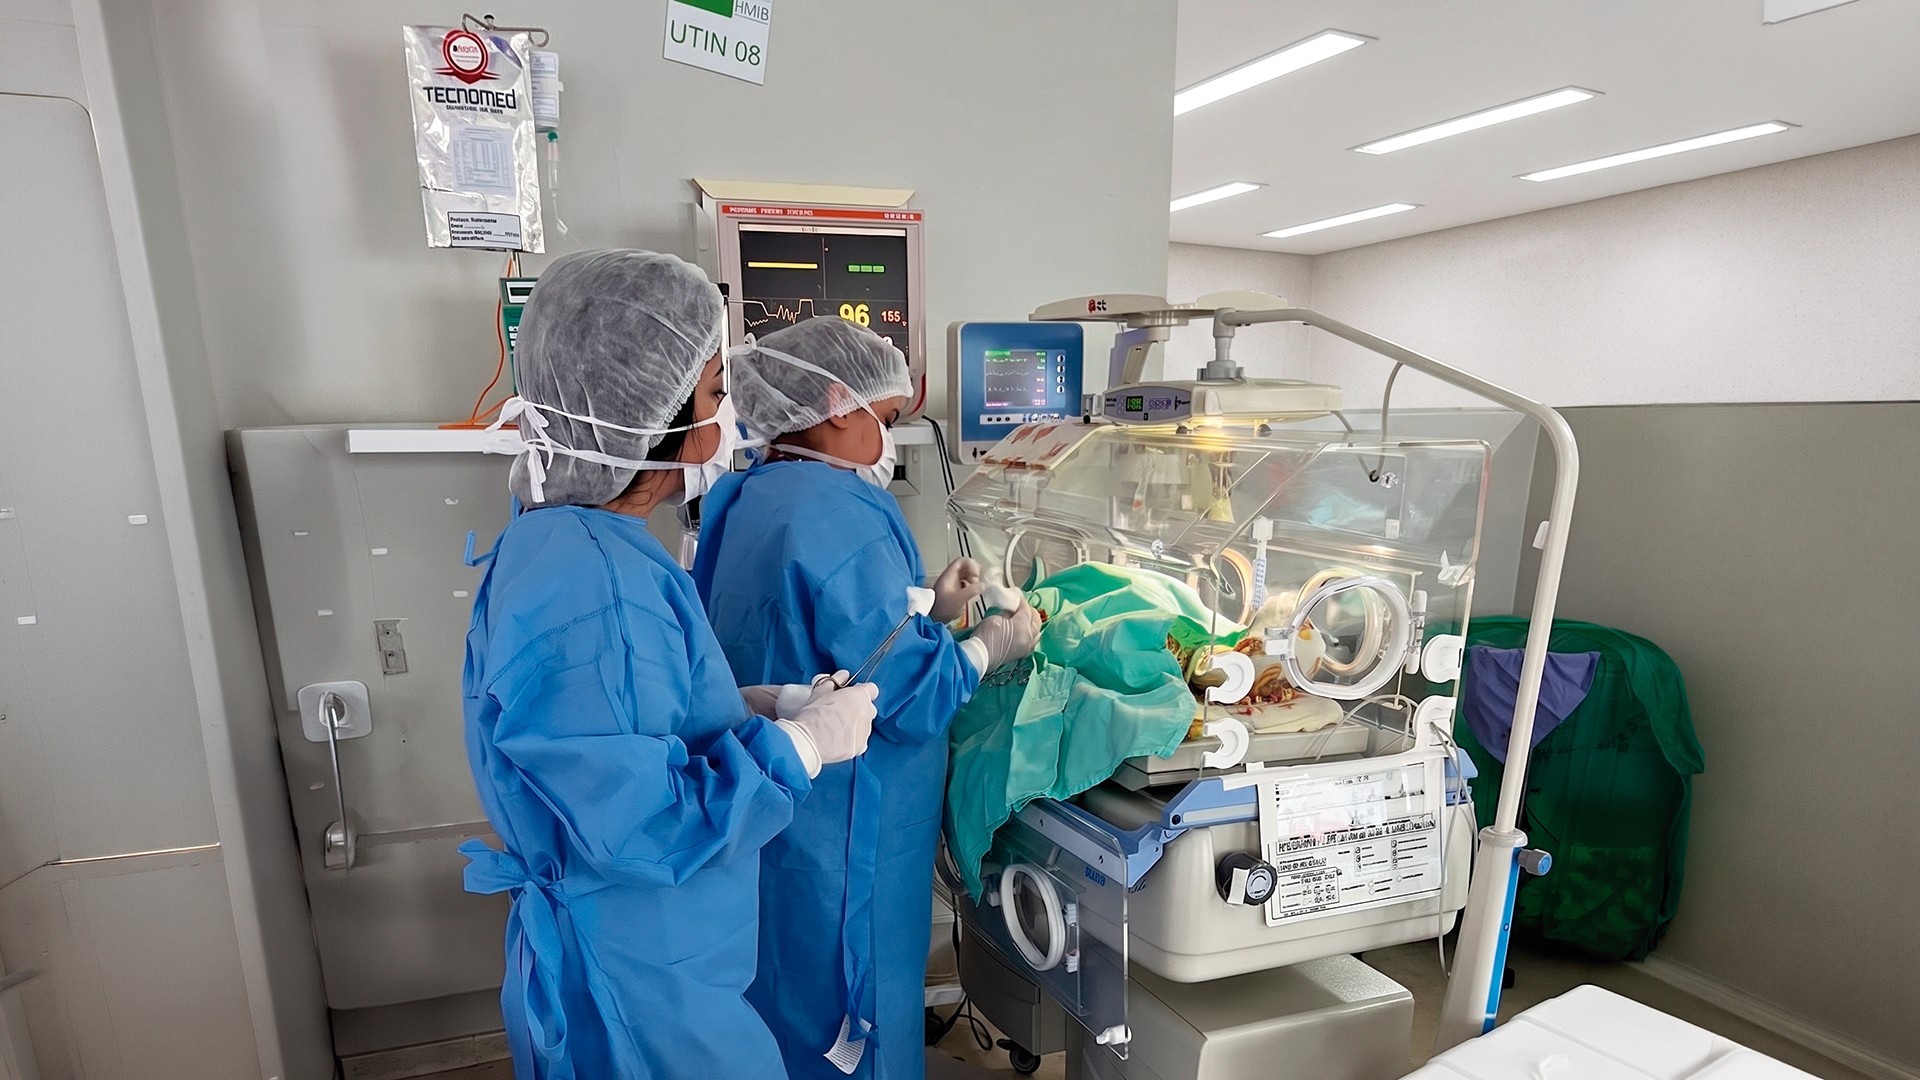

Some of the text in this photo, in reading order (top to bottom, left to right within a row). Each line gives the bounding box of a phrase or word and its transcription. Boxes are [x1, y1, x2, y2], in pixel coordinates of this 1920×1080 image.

[735, 0, 769, 21] HMIB
[671, 20, 760, 66] UTIN 08
[839, 303, 870, 328] 96
